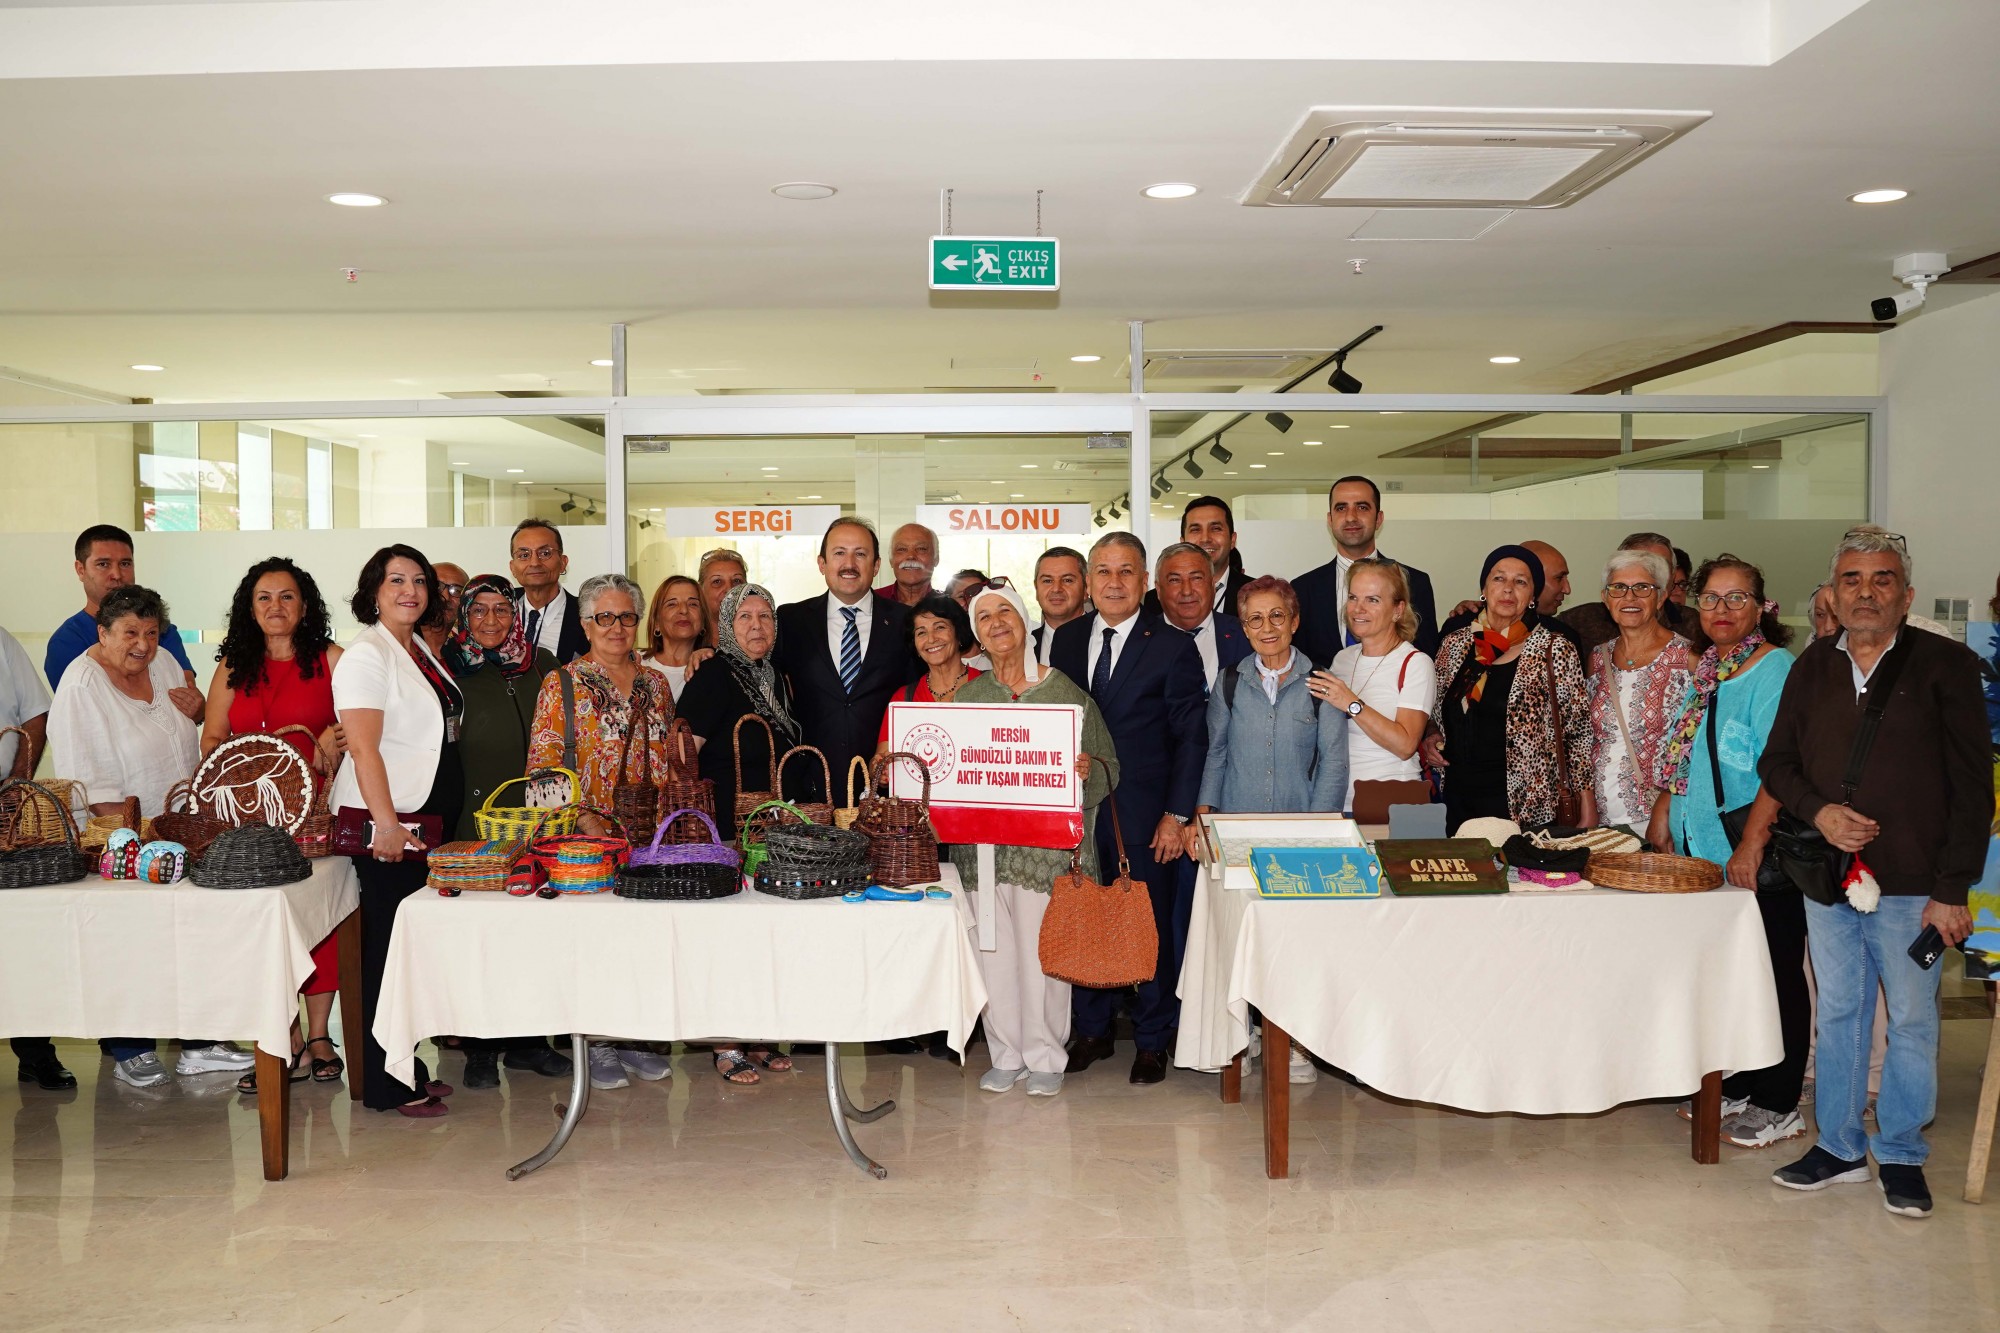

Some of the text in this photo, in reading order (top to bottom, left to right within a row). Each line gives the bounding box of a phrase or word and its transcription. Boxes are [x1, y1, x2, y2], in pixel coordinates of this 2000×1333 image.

[1007, 249, 1050, 265] ÇIKIŞ
[1008, 265, 1048, 279] EXIT
[948, 508, 1060, 531] SALONU
[991, 725, 1030, 743] MERSİN
[960, 746, 1063, 766] GÜNDÜZLÜ BAKIM VE
[956, 767, 1067, 789] AKTİF YAŞAM MERKEZİ
[1410, 858, 1470, 873] CAFE
[1410, 873, 1478, 883] DE PARIS
